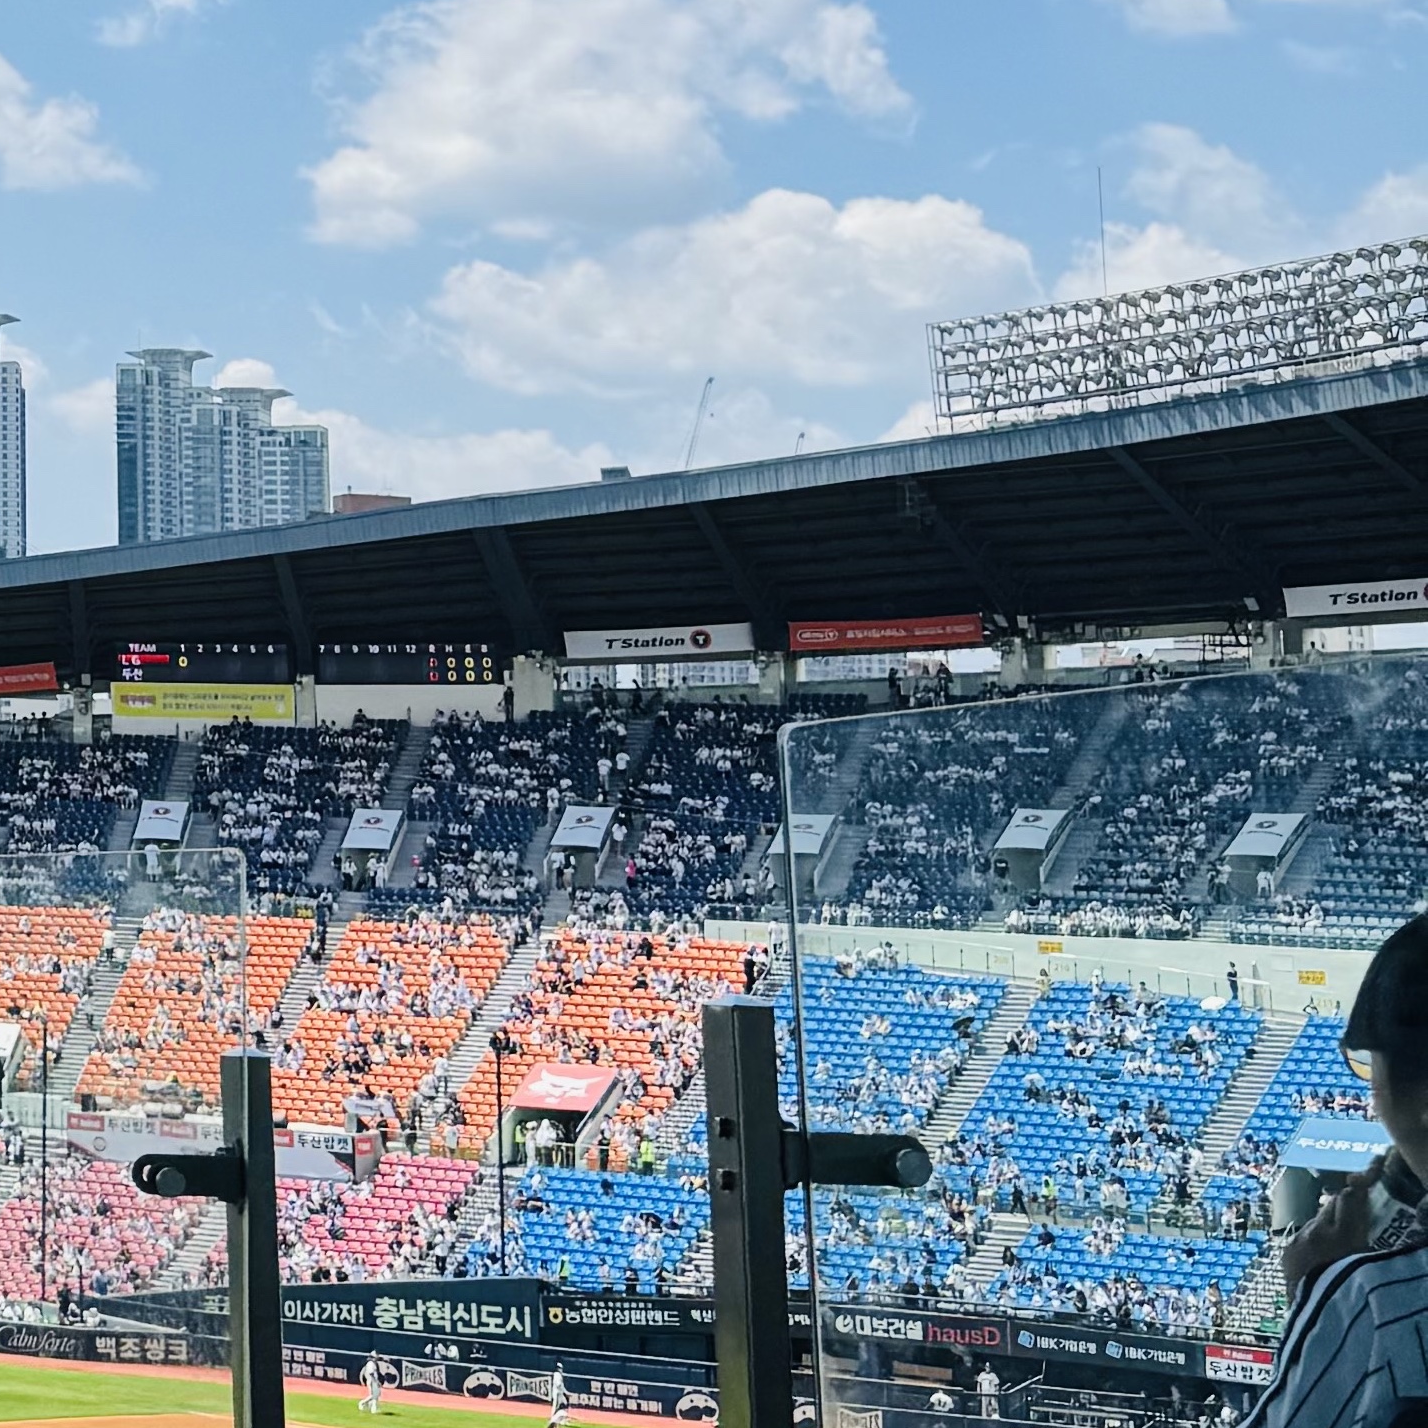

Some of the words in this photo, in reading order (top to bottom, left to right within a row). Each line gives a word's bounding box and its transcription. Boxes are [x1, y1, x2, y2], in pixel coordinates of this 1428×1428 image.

[128, 643, 157, 653] TEAM
[180, 644, 186, 653] 1
[197, 644, 204, 653] 2
[215, 644, 222, 653] 3
[231, 644, 239, 653] 4
[249, 644, 257, 654] 5
[267, 644, 275, 654] 6
[319, 644, 326, 653] 7
[351, 644, 359, 654] 9
[368, 644, 380, 654] 10
[386, 644, 397, 654] 11
[405, 644, 417, 654] 12
[178, 656, 188, 668] 0
[446, 657, 456, 669] 0
[464, 657, 474, 669] 0
[482, 657, 492, 668] 0
[447, 670, 457, 682] 0
[465, 670, 475, 682] 0
[483, 670, 493, 682] 0
[298, 1134, 349, 1150] 두산밥캣
[284, 1300, 364, 1325] 이사가자!
[373, 1296, 532, 1338] 충남혁신도시
[927, 1321, 1001, 1346] hausD
[95, 1336, 189, 1362] 백조씽크
[509, 1374, 550, 1398] PRINGLES
